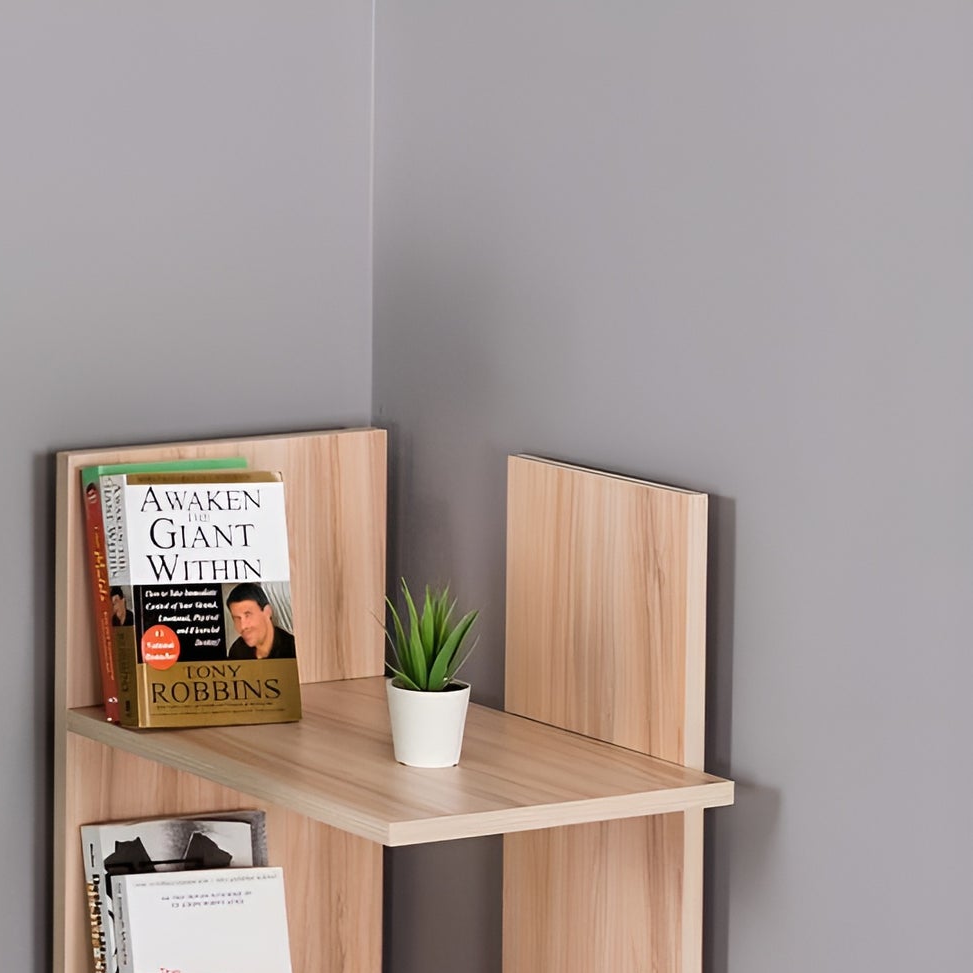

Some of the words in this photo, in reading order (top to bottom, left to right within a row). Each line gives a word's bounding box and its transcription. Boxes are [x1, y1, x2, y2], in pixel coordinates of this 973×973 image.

[141, 486, 261, 512] AWAKEN
[149, 517, 255, 550] GIANT
[146, 554, 262, 581] WITHIN
[183, 664, 241, 679] TONY
[151, 678, 281, 704] ROBBINS
